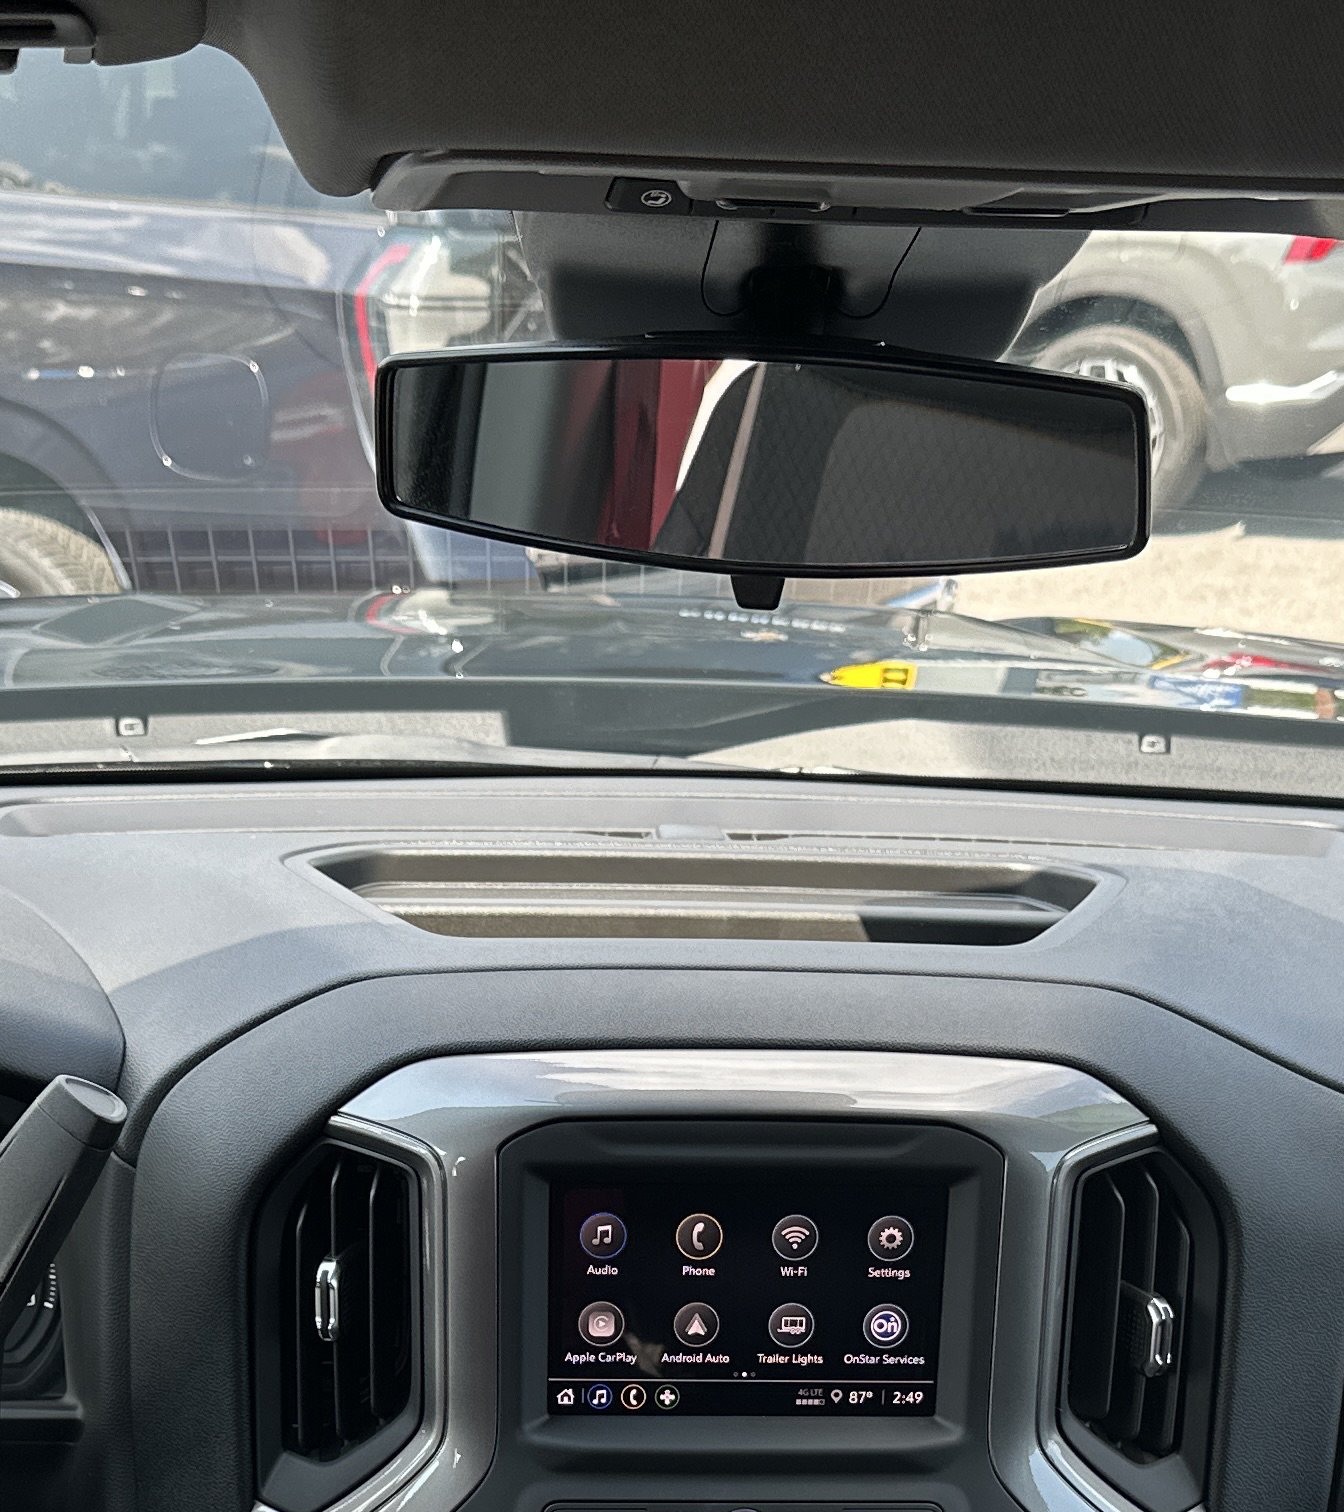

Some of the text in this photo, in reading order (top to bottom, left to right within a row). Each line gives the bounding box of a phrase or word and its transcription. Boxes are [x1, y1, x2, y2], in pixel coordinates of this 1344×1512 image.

[586, 1265, 619, 1276] Audio
[682, 1265, 716, 1276] Phone
[780, 1266, 808, 1277] Wi-Fi
[867, 1267, 911, 1280] Settings
[564, 1352, 637, 1365] Apple CarPlay
[661, 1353, 730, 1364] Android Auto
[757, 1353, 824, 1366] Trailer Lights
[843, 1354, 925, 1365] OnStar Services
[892, 1391, 924, 1404] 2:49
